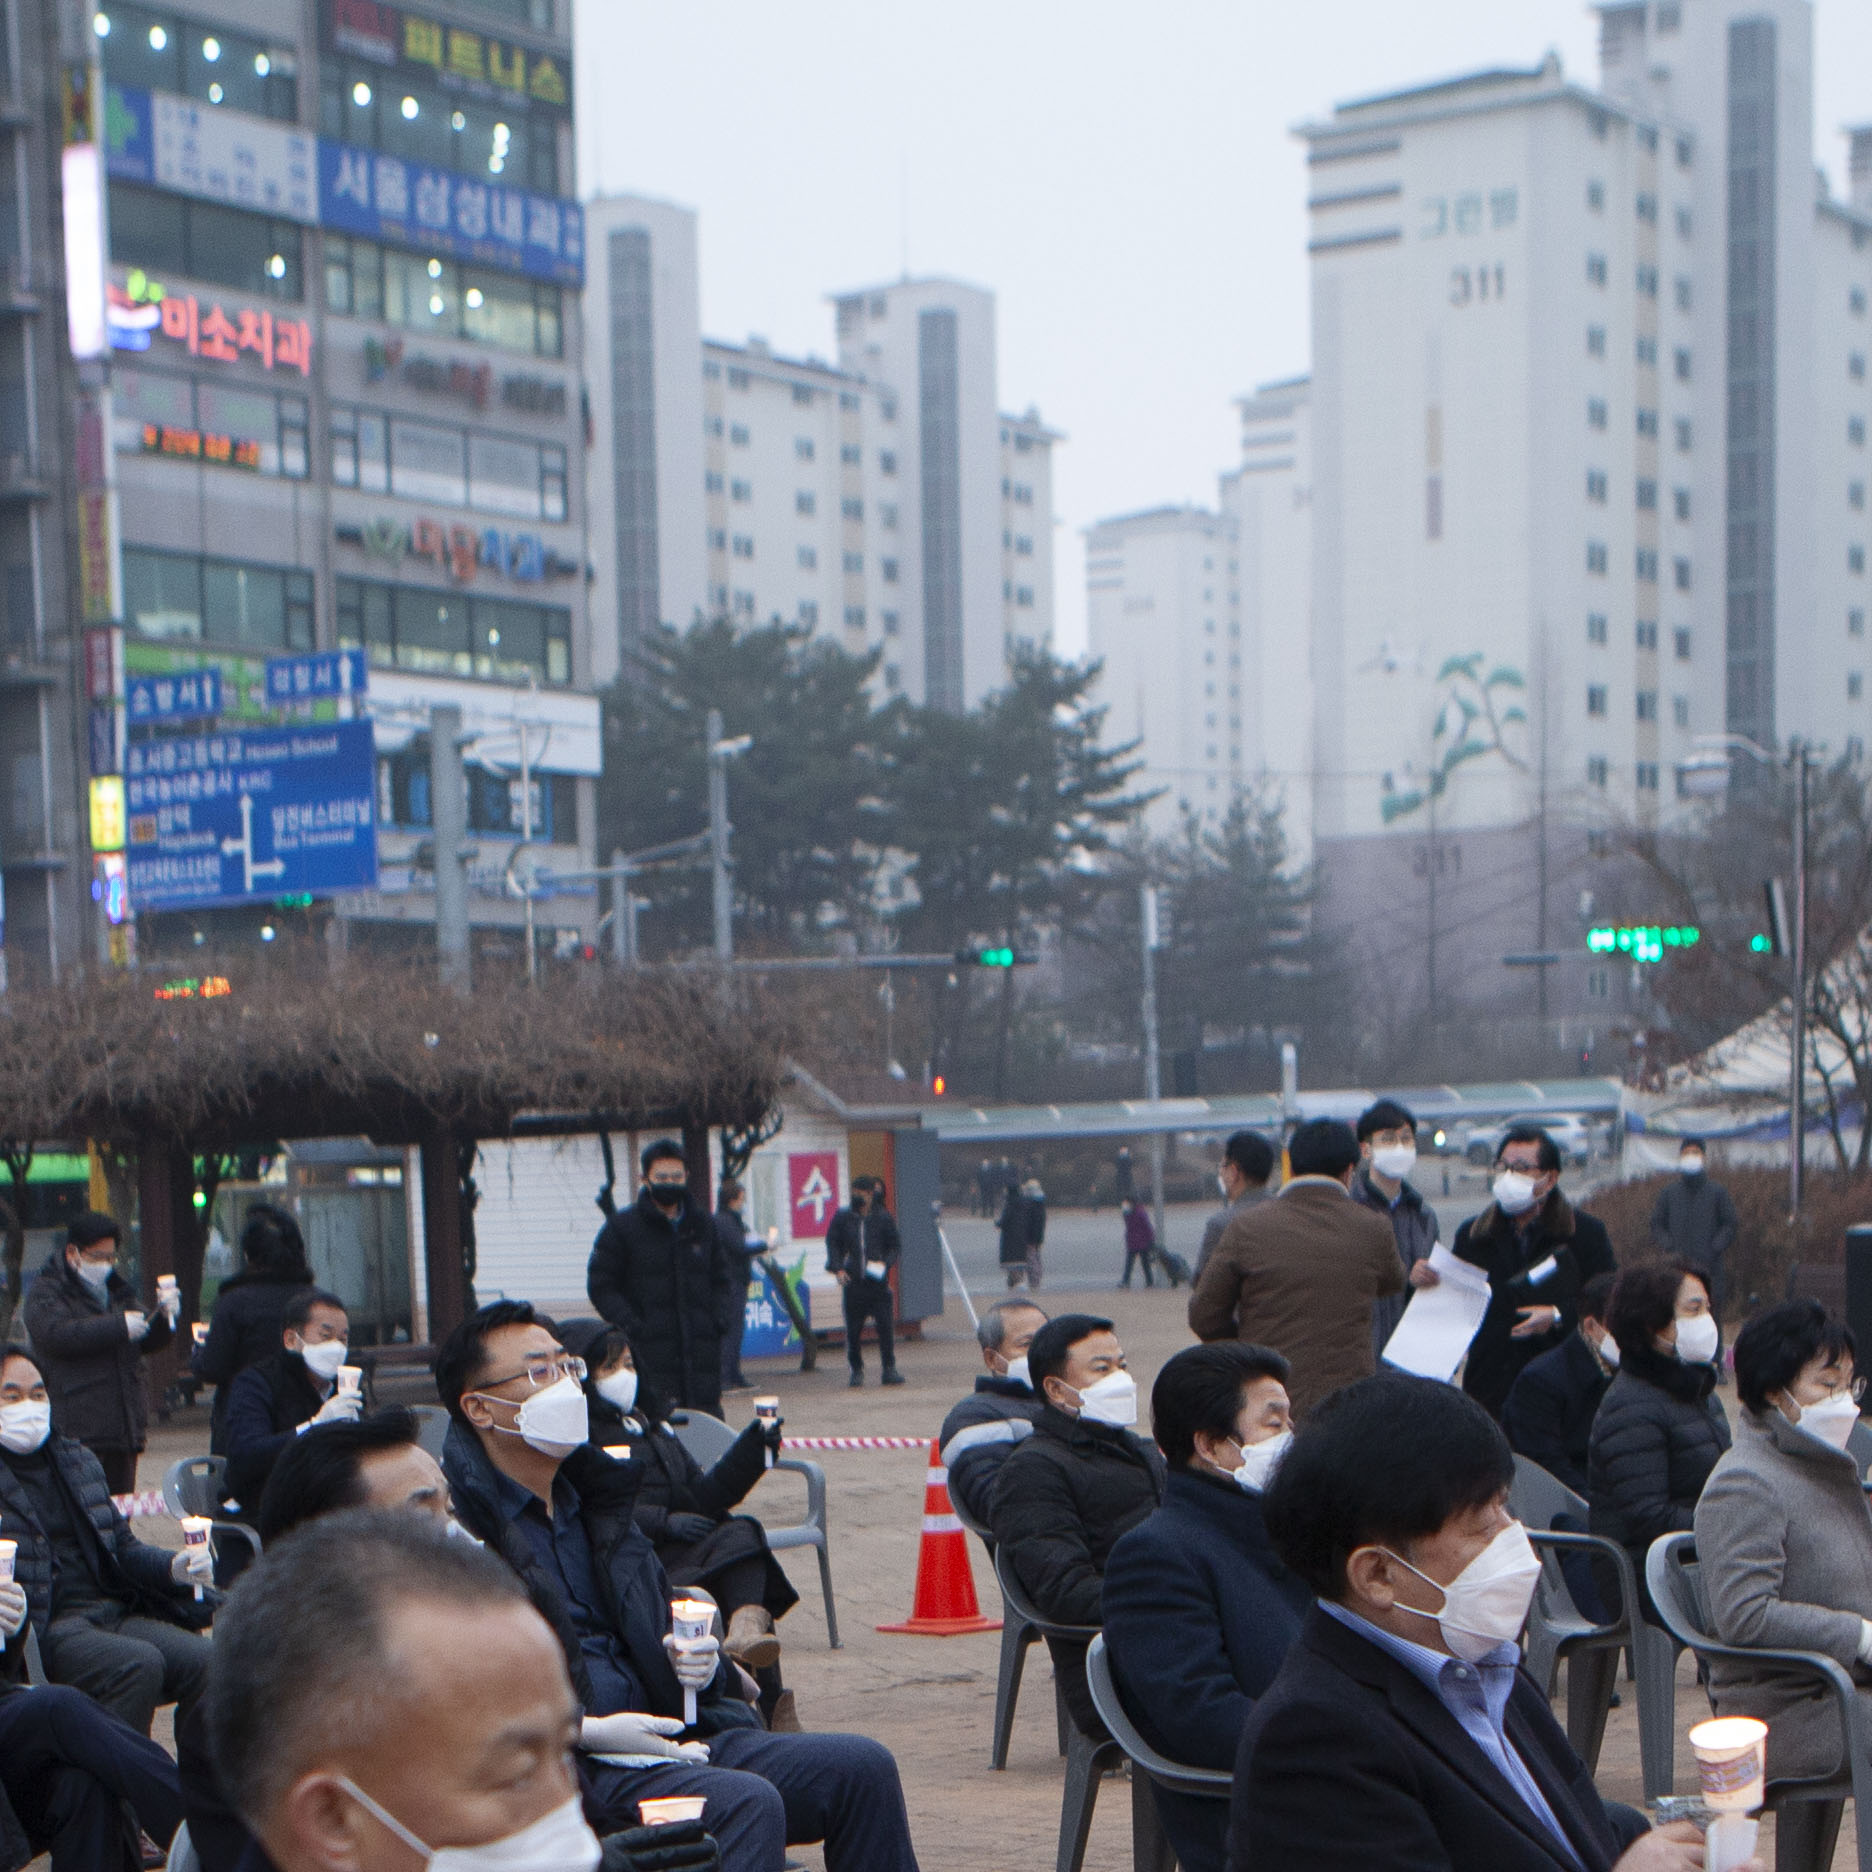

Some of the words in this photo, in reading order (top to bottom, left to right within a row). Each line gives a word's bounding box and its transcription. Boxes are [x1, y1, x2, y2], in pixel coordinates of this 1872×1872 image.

[404, 16, 568, 104] 피트니스
[333, 150, 560, 254] 서울삼성내과
[1450, 262, 1506, 304] 311
[132, 678, 198, 715] 소방서
[301, 827, 356, 848] Terminal
